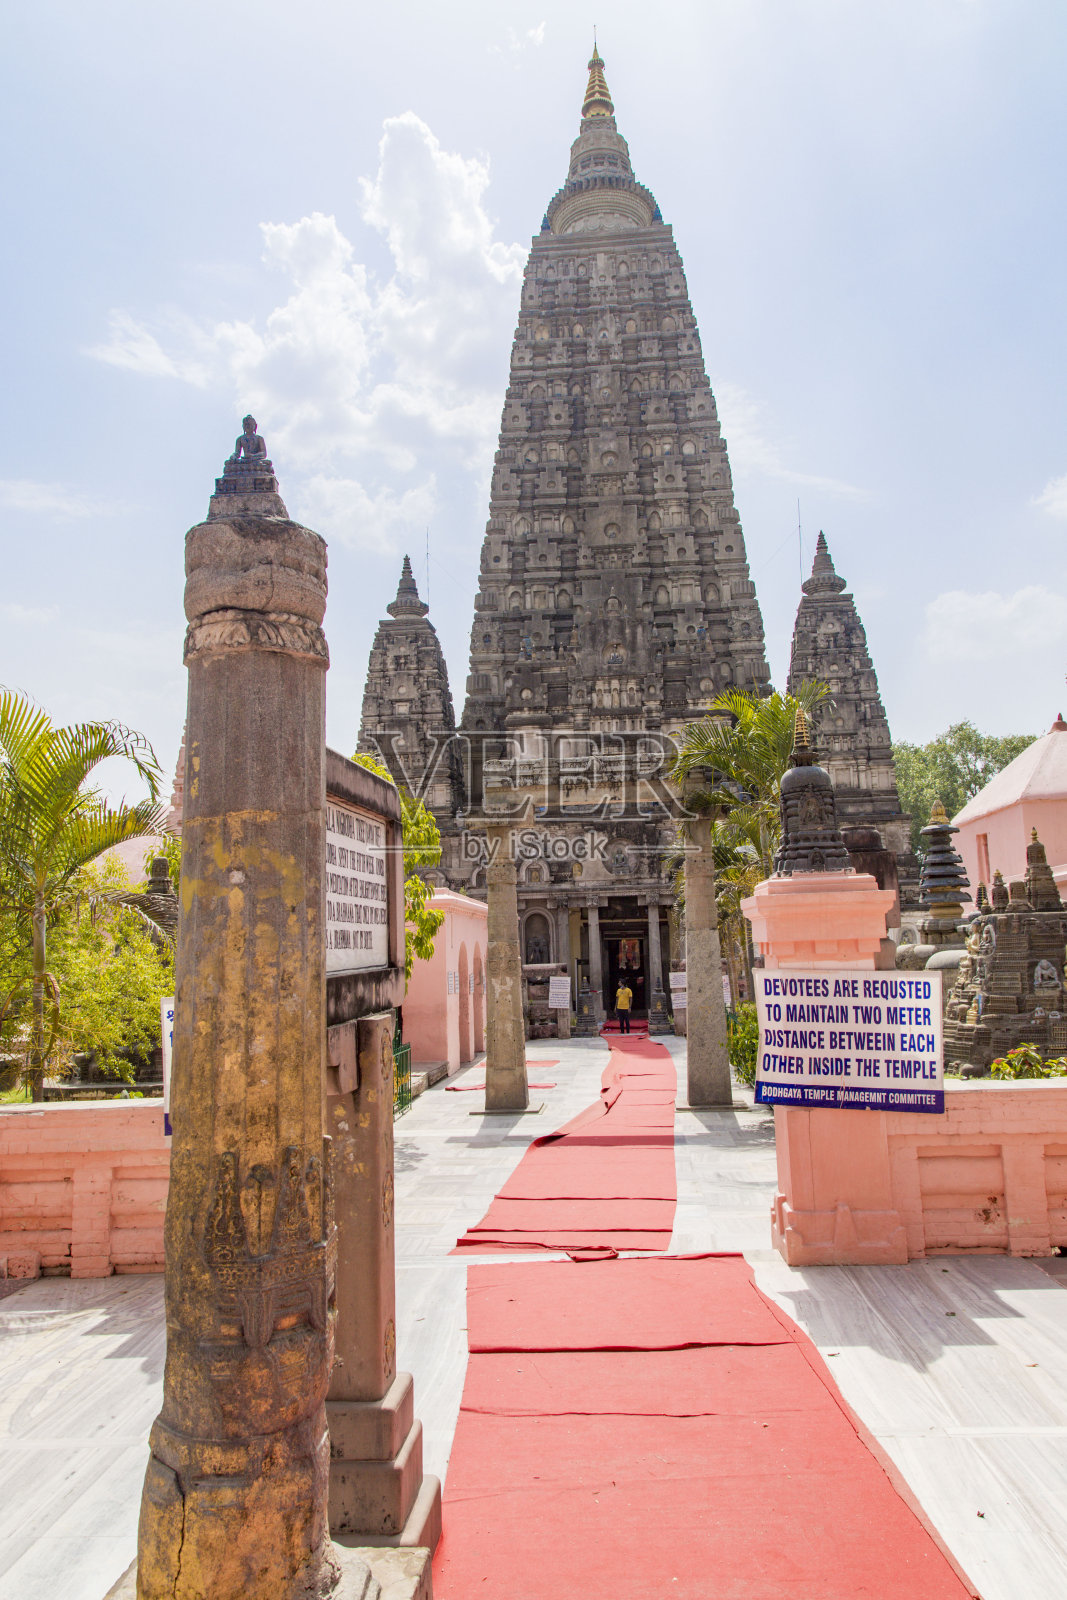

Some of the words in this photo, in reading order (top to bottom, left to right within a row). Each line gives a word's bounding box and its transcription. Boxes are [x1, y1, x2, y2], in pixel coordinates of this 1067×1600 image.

[764, 978, 829, 997] DEVOTEES
[833, 979, 859, 998] ARE
[864, 980, 931, 1001] REQUSTED
[765, 1003, 782, 1022] TO
[786, 1004, 849, 1024] MAINTAIN
[852, 1005, 882, 1025] TWO
[886, 1007, 931, 1026] METER
[764, 1029, 825, 1049] DISTANCE
[829, 1031, 896, 1051] BETWEEIN
[900, 1034, 935, 1053] EACH
[762, 1053, 804, 1074] OTHER
[808, 1057, 851, 1076] INSIDE
[855, 1058, 880, 1078] THE
[884, 1060, 937, 1080] TEMPLE
[762, 1085, 802, 1099] BODHGAYA
[803, 1089, 835, 1101] TEMPLE
[836, 1090, 887, 1104] MANAGEMNT
[889, 1093, 936, 1105] COMMITTEE
